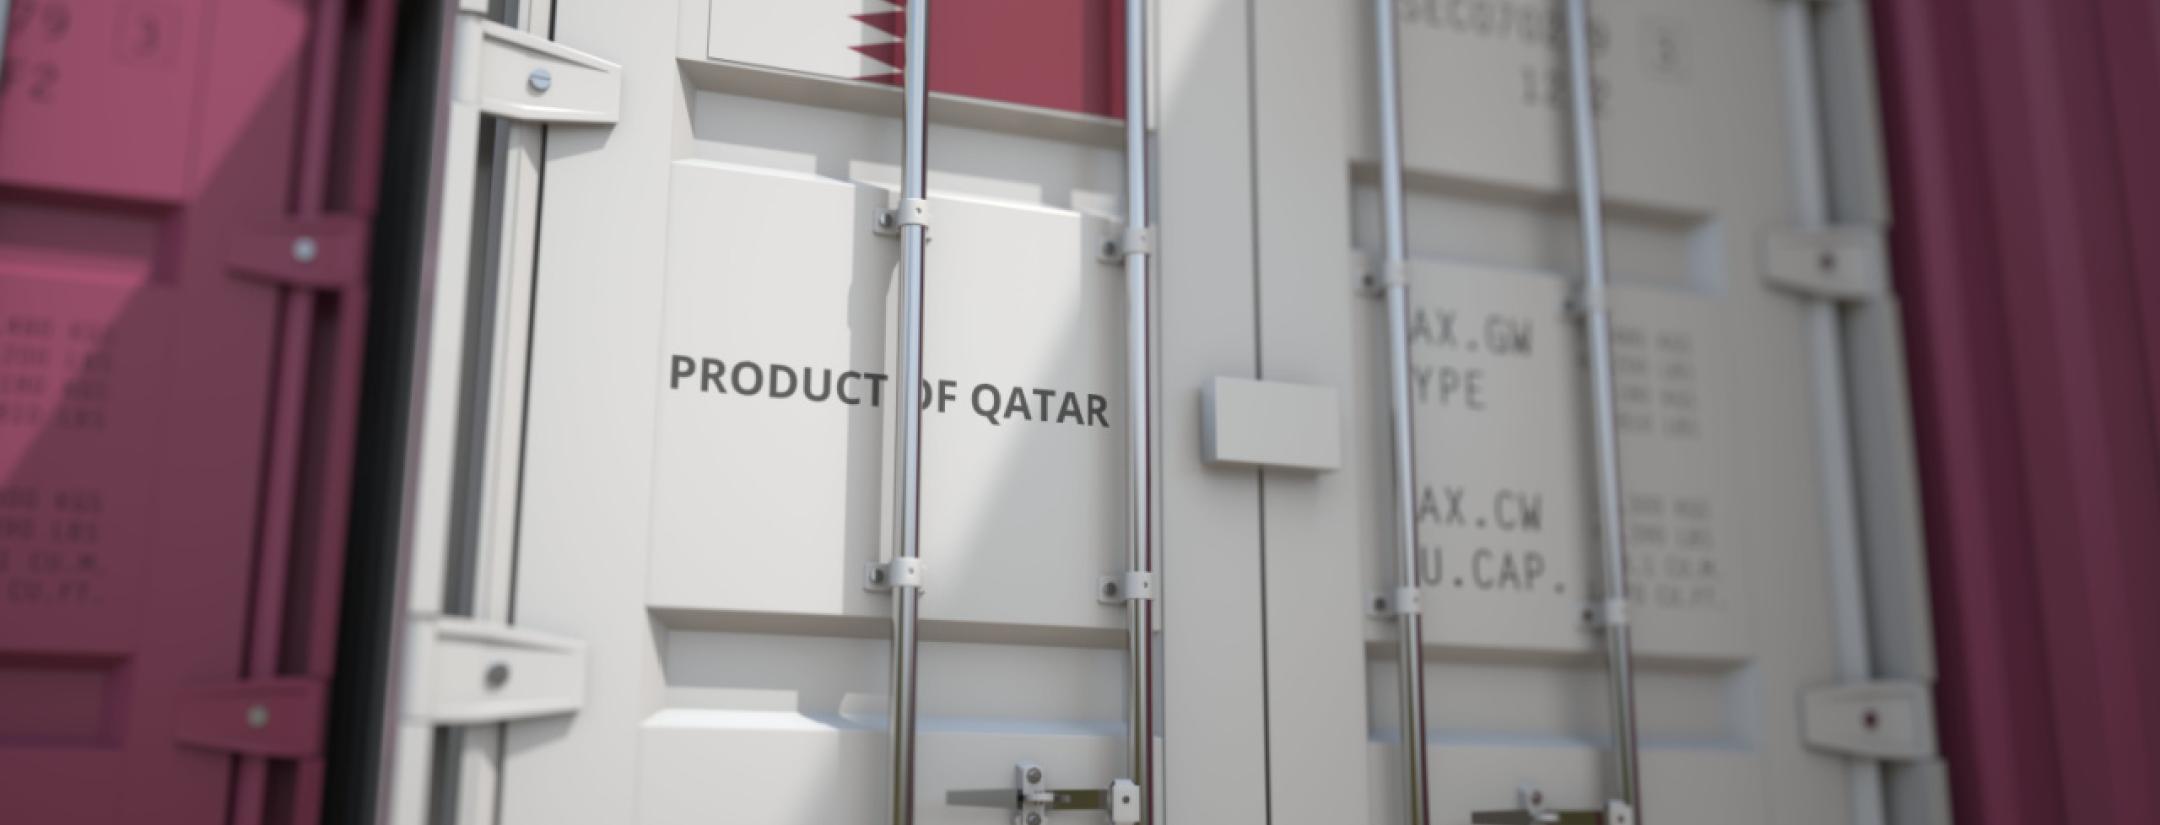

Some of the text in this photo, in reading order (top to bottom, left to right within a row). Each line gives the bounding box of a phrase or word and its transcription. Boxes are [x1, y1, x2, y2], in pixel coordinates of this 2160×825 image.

[1410, 307, 1534, 357] AX.GW
[669, 354, 888, 407] PRODUCT
[971, 382, 1110, 428] QATAR
[1411, 364, 1487, 411] YPE
[1418, 485, 1543, 532] AX.CW
[1420, 546, 1566, 595] U.CAP.
